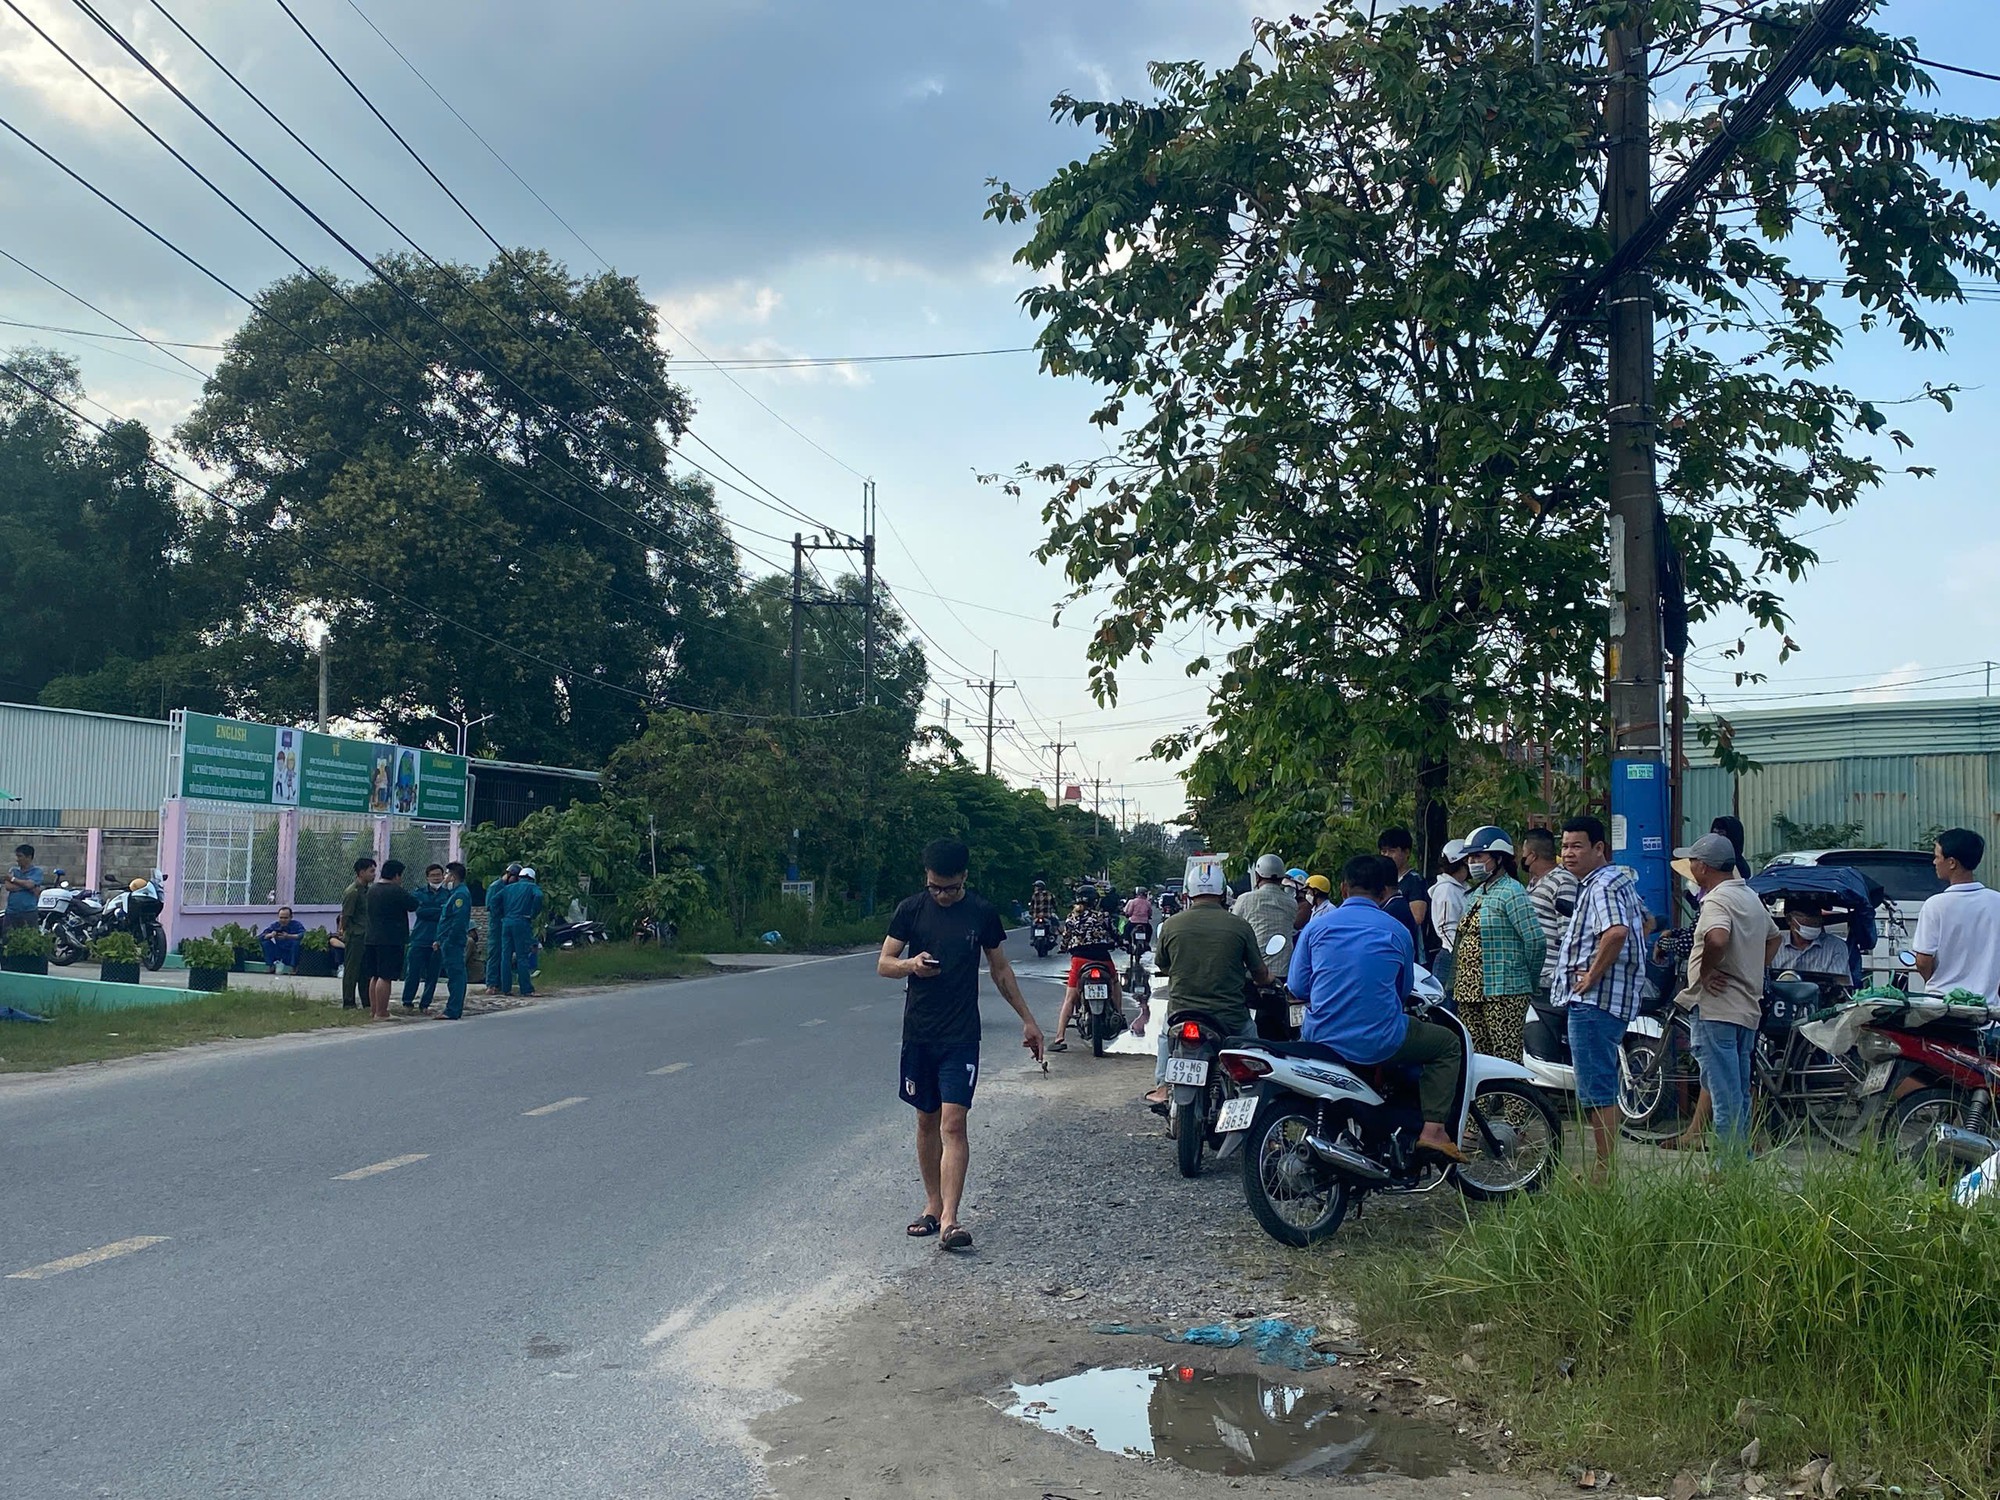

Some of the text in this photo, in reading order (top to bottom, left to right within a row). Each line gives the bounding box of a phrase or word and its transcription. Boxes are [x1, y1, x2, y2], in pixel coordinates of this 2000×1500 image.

[215, 724, 247, 741] ENGLISH
[1173, 1060, 1202, 1073] 49-M6
[965, 1063, 976, 1087] 7
[1172, 1071, 1200, 1084] 3761
